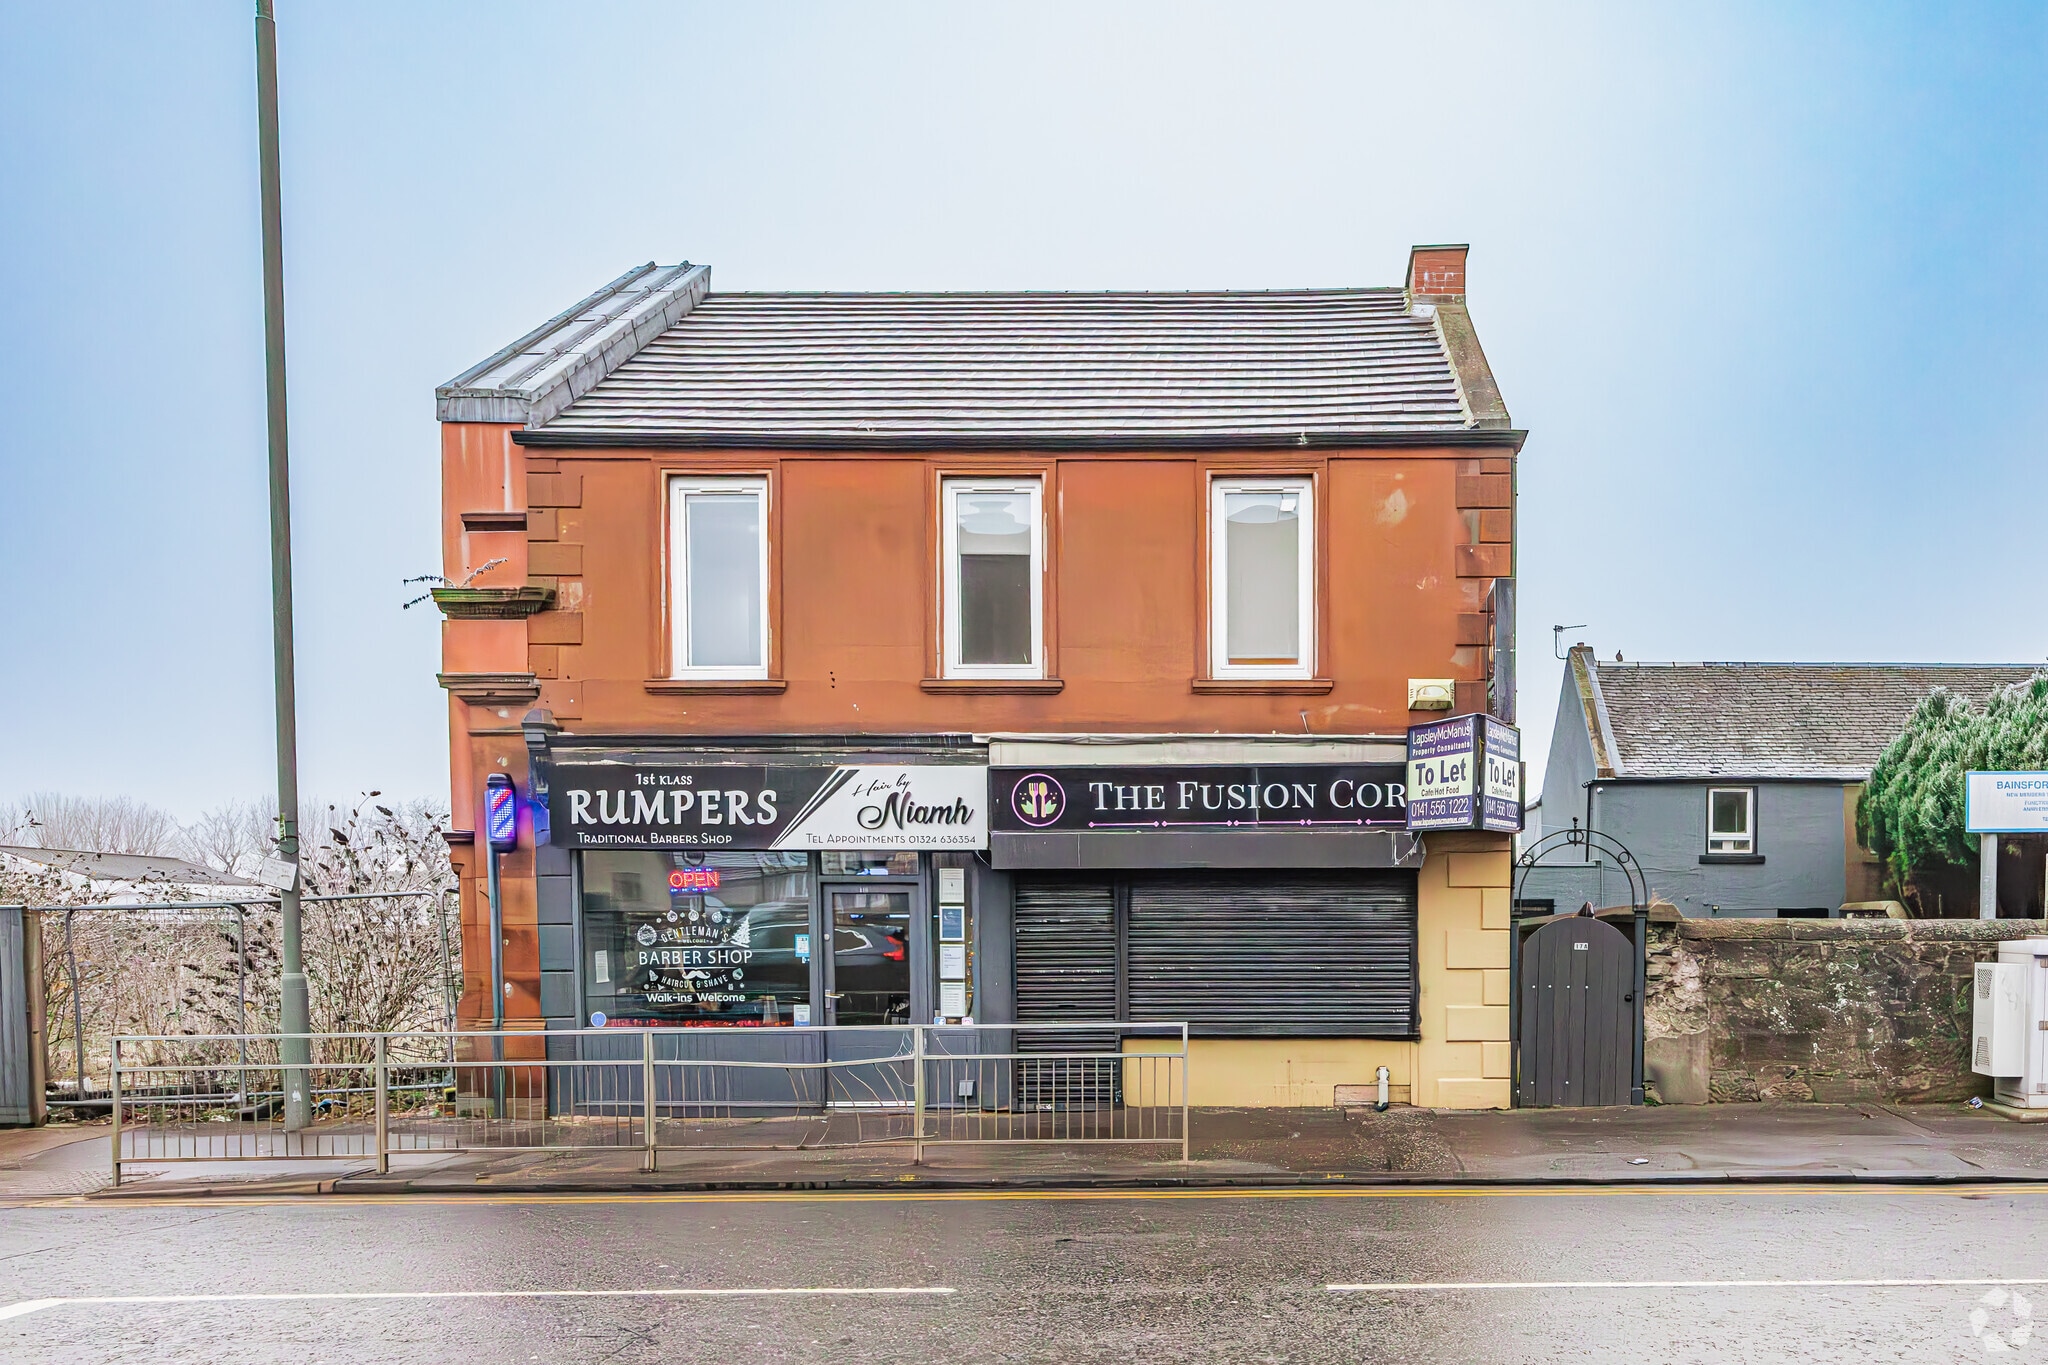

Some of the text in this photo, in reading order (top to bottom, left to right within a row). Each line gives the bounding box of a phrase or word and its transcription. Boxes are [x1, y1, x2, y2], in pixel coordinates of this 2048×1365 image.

[1412, 747, 1435, 757] Property
[635, 773, 693, 786] 1st KLASS
[1415, 757, 1467, 786] To Let
[1488, 757, 1516, 788] To Let
[851, 773, 912, 797] Hair by
[1445, 784, 1460, 795] Food
[1089, 778, 1407, 811] THE FUSION COR
[566, 789, 778, 826] RUMPERS
[857, 791, 975, 831] Niamh
[1411, 797, 1469, 817] 0141 556 1222
[1485, 798, 1517, 819] 0141 556 1222
[577, 832, 733, 845] TRADITIONAL BARBERS SHOP
[806, 833, 976, 844] TEL APPOINTMENTS 01324 636354
[669, 871, 719, 888] OPEN
[660, 925, 730, 944] GENTLEMAN'S
[639, 949, 753, 966] BARBER SHOP
[703, 973, 729, 989] SHAVE
[645, 992, 746, 1003] Walk-ins Welcome
